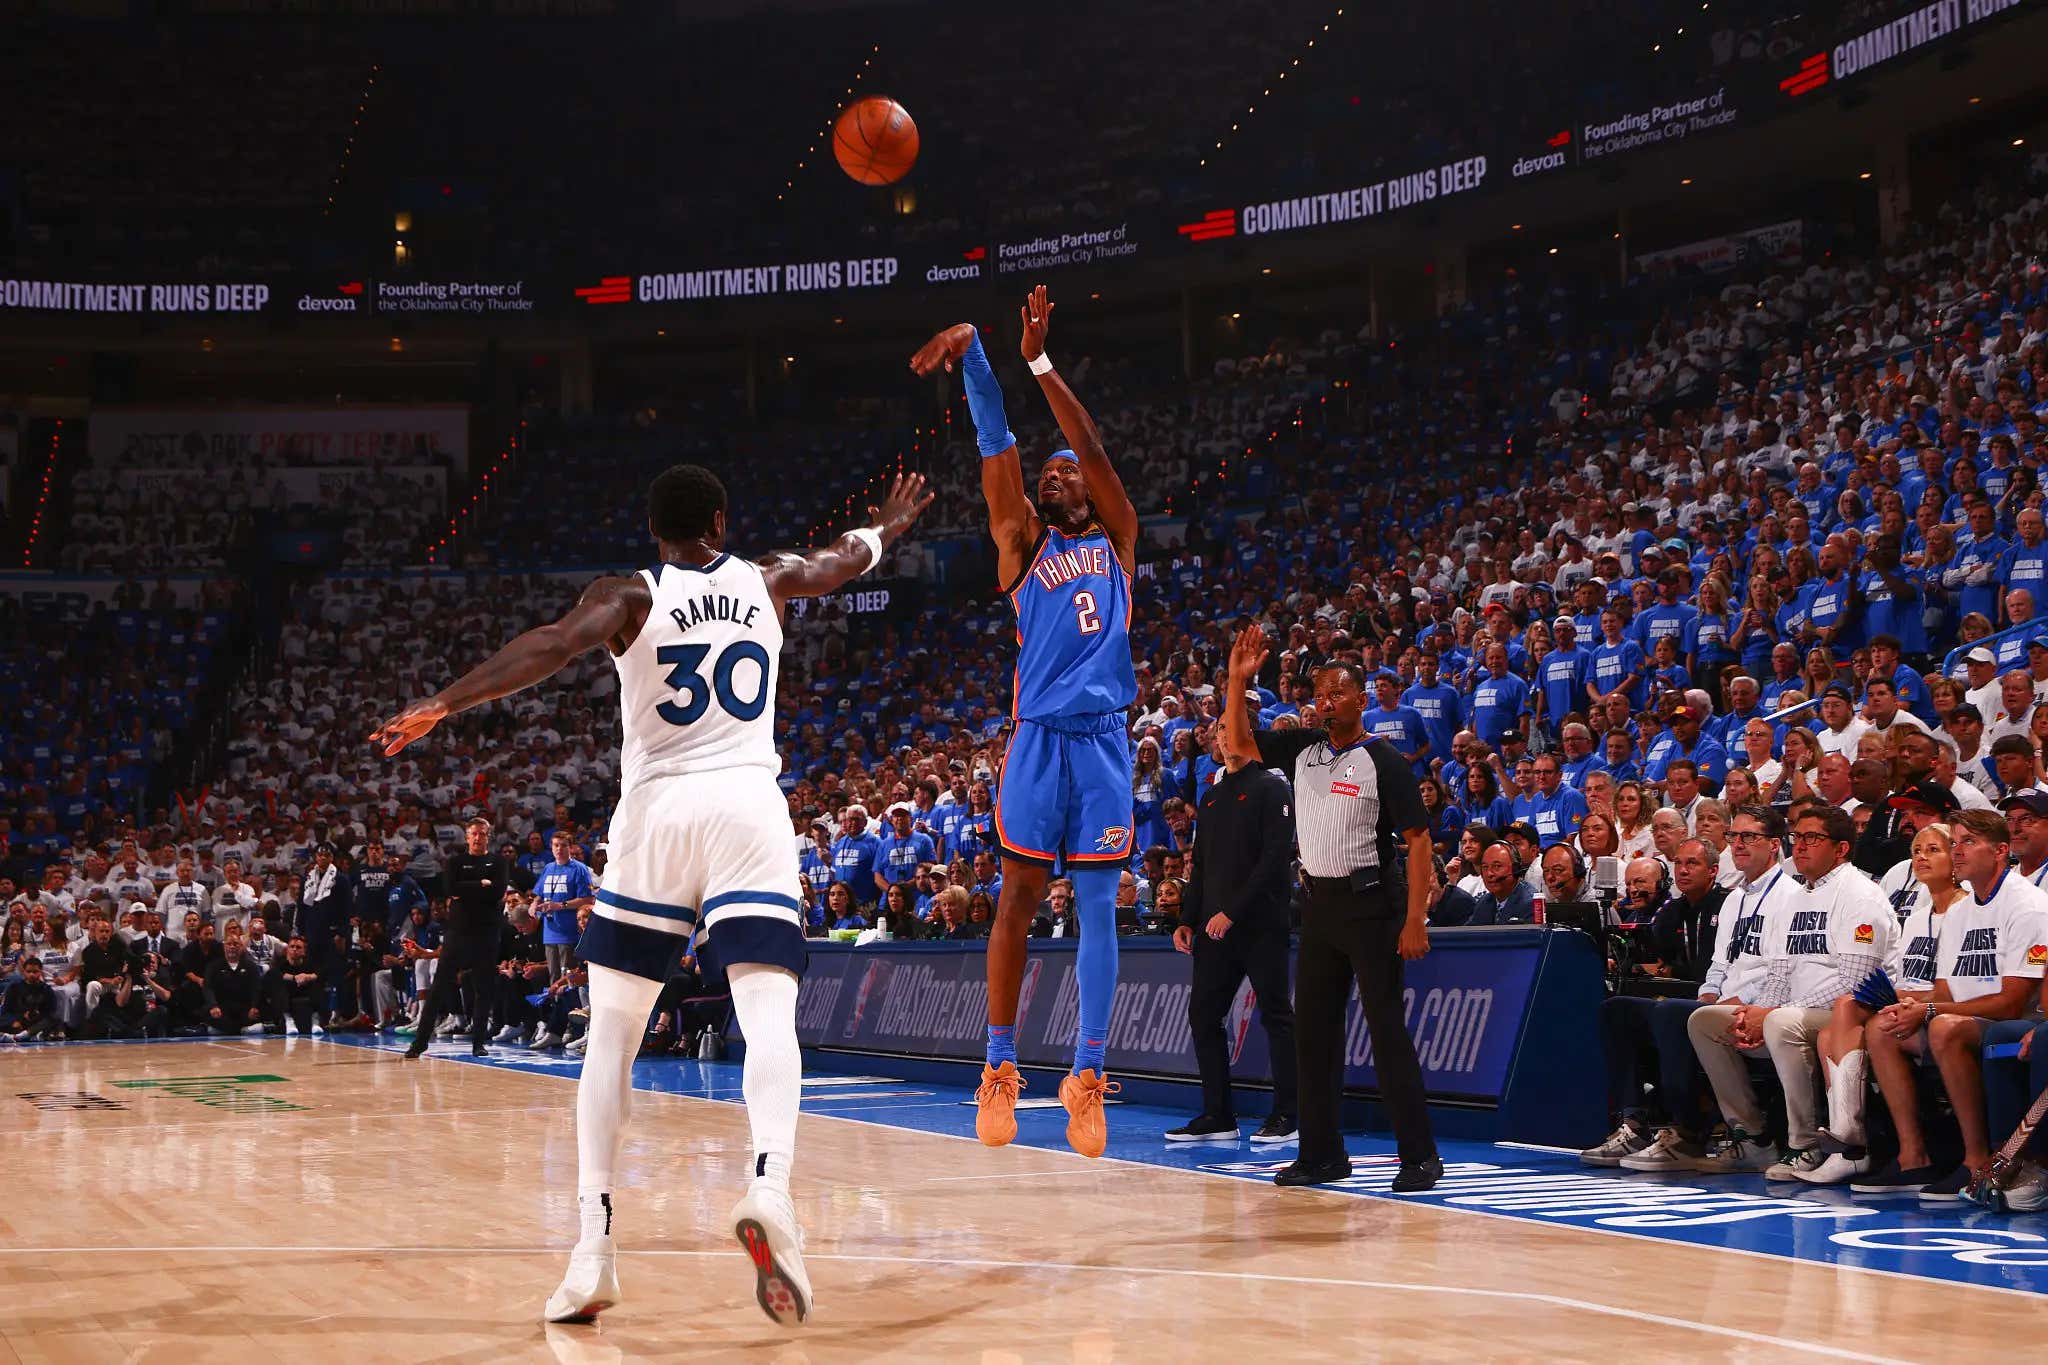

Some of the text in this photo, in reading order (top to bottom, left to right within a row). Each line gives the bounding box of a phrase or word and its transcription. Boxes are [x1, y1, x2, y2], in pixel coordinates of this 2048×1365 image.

[1833, 0, 2021, 80] COMMITMENT RU
[1584, 88, 1724, 141] Founding Partner of
[1584, 108, 1737, 159] the Oklahoma City Thunder
[1512, 150, 1566, 177] devon
[1243, 155, 1487, 235] COMMITMENT RUNS DEEP
[999, 223, 1128, 258] Founding Partner of
[1000, 241, 1138, 273] the Oklahoma City Thunder
[379, 281, 523, 299] Founding Partner of
[638, 257, 898, 302] COMMITMENT RUNS DEEP
[926, 263, 980, 282] devon
[151, 284, 210, 311] RUNS
[215, 284, 269, 311] DEEP
[298, 296, 356, 312] devon
[379, 299, 534, 313] the Oklahoma City Thunder
[669, 594, 760, 633] RANDLE
[856, 590, 890, 613] DEEP
[1073, 590, 1101, 635] 2
[655, 640, 770, 727] 30
